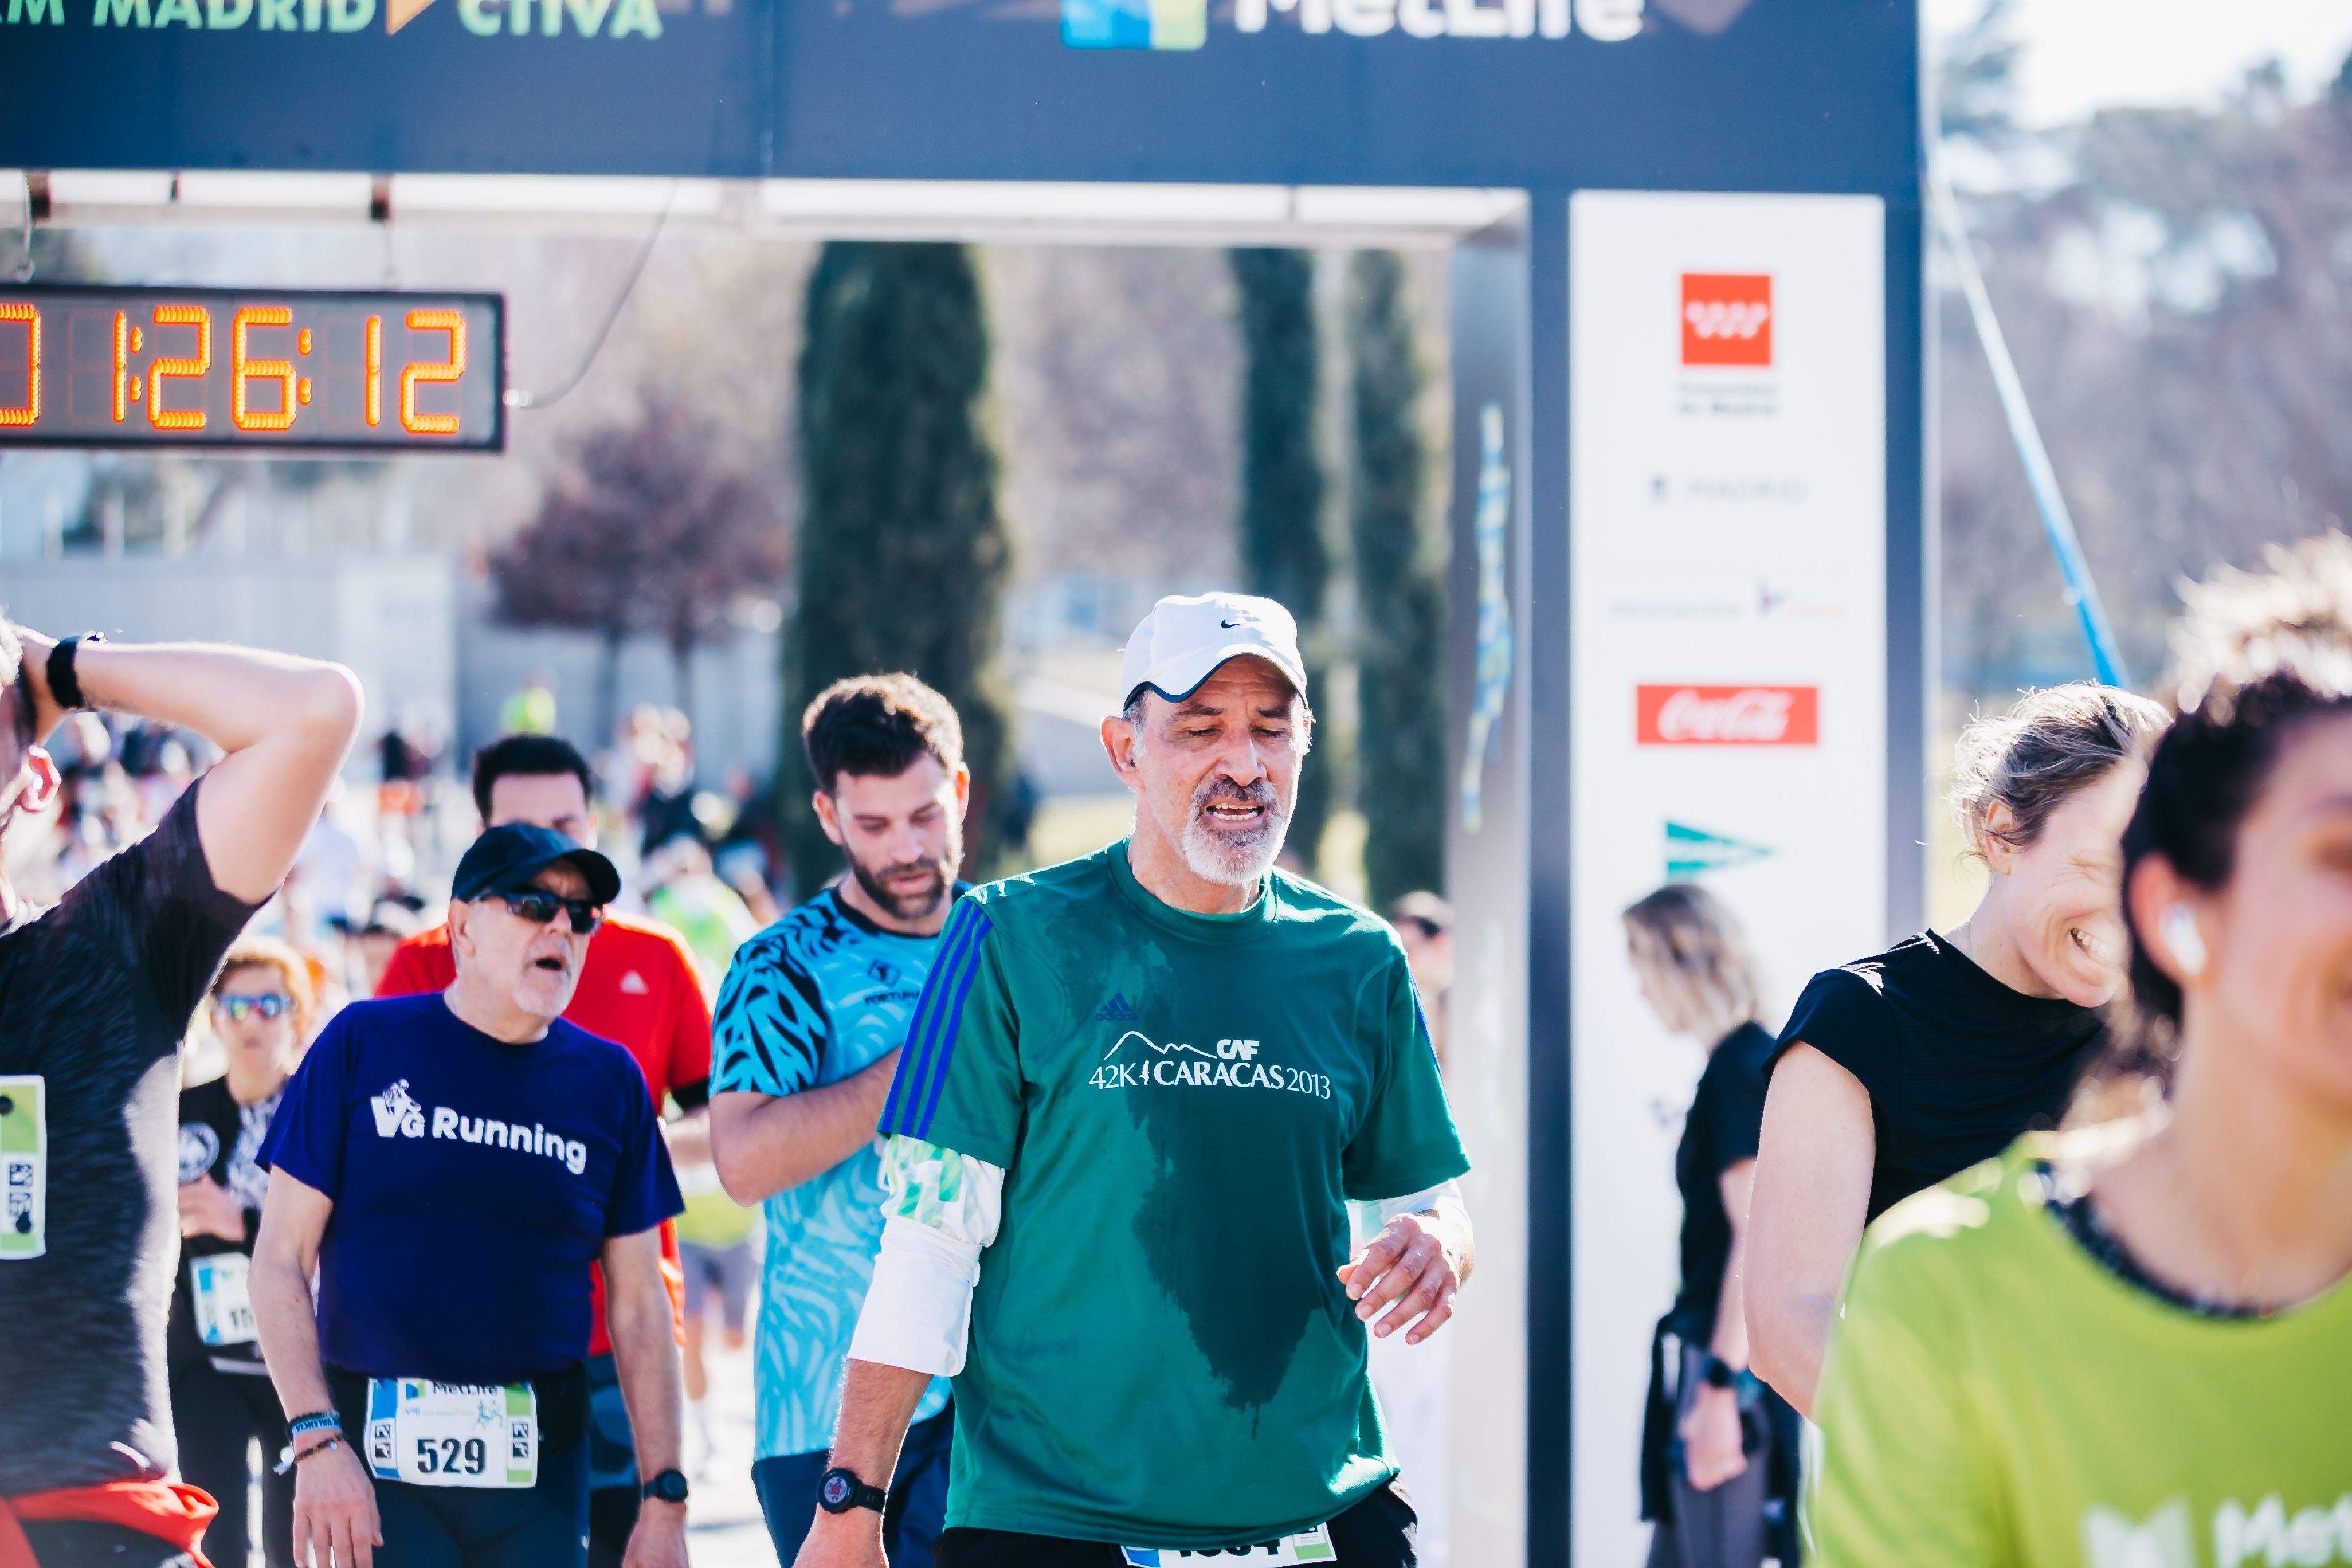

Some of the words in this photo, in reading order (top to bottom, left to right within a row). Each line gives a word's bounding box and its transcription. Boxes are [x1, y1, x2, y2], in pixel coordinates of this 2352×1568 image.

[1216, 1039, 1260, 1060] CAF
[1089, 1062, 1138, 1089] 42K
[1154, 1060, 1285, 1090] CARACAS
[1286, 1068, 1331, 1099] 2013
[433, 1106, 587, 1175] Running
[417, 1437, 487, 1475] 529
